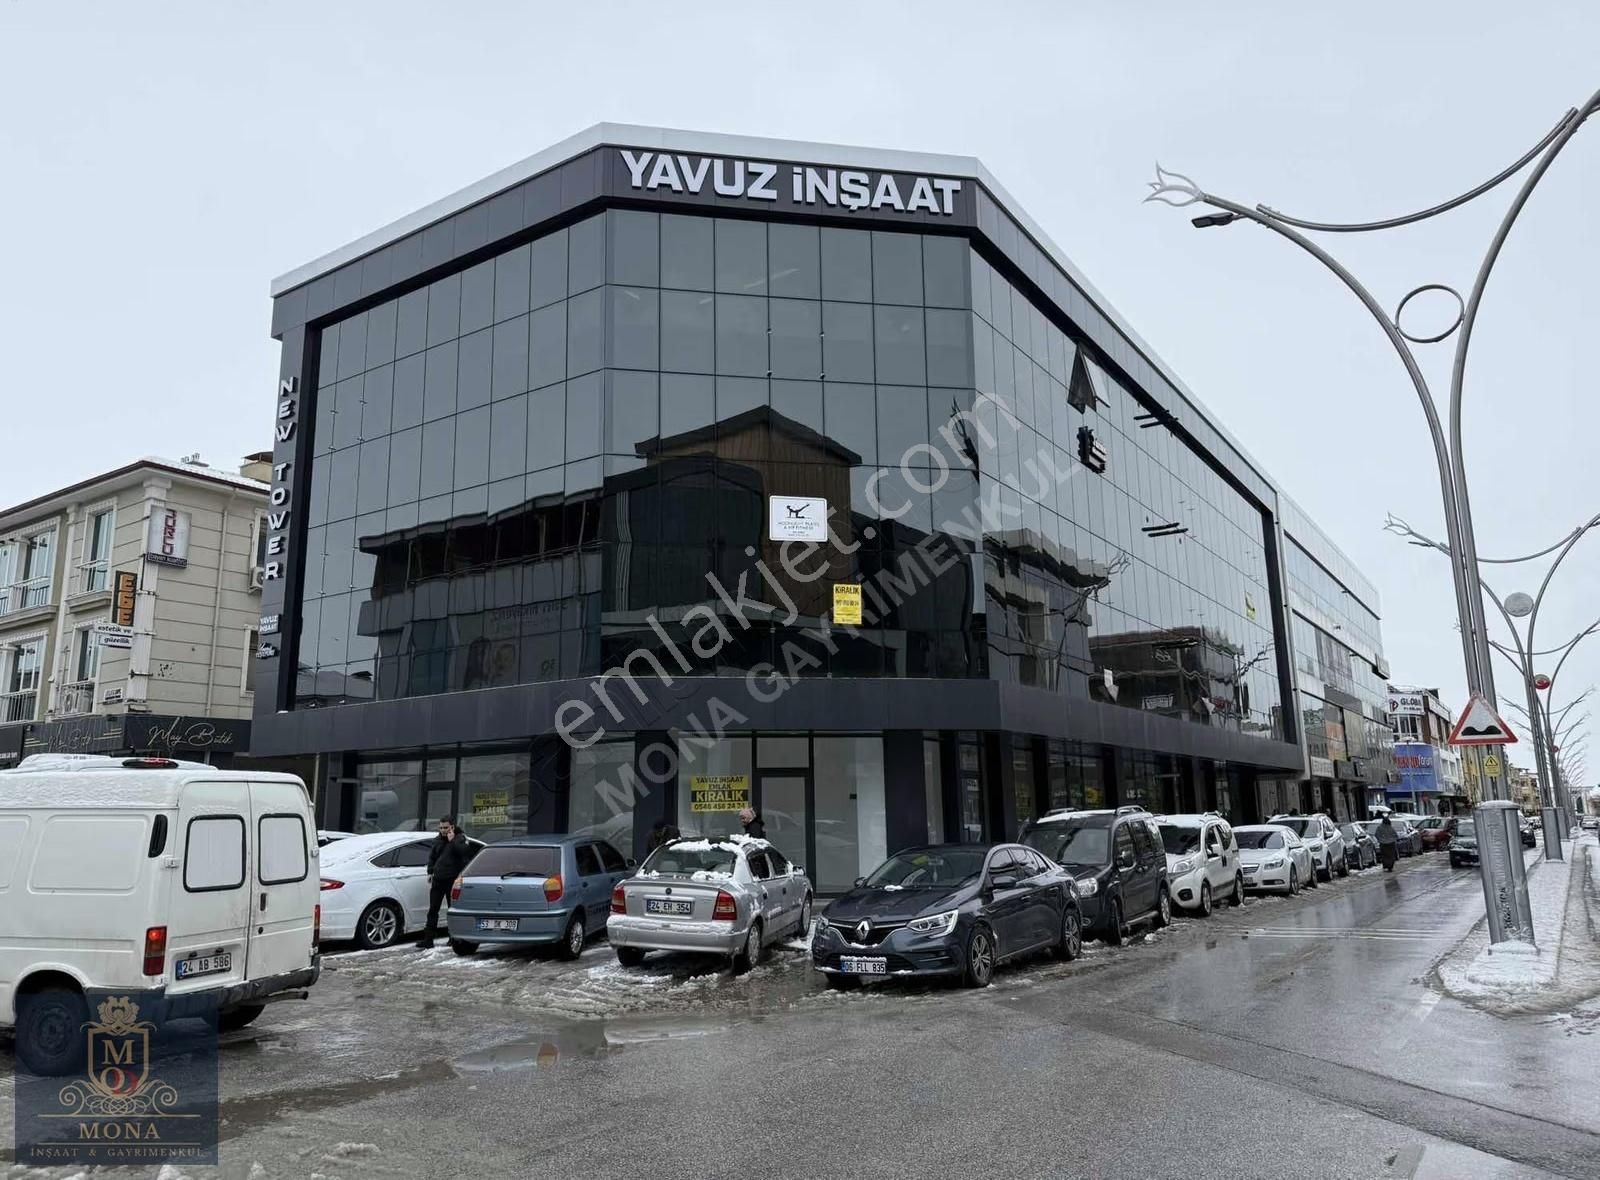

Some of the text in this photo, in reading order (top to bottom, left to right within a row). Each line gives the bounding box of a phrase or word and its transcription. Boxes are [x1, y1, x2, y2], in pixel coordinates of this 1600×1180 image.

[620, 150, 777, 200] YAVUZ
[265, 377, 294, 580] NEW TOWER
[651, 901, 660, 909] 24
[676, 902, 690, 911] 354
[182, 961, 193, 973] 24
[213, 955, 230, 969] 586
[872, 963, 885, 972] 835
